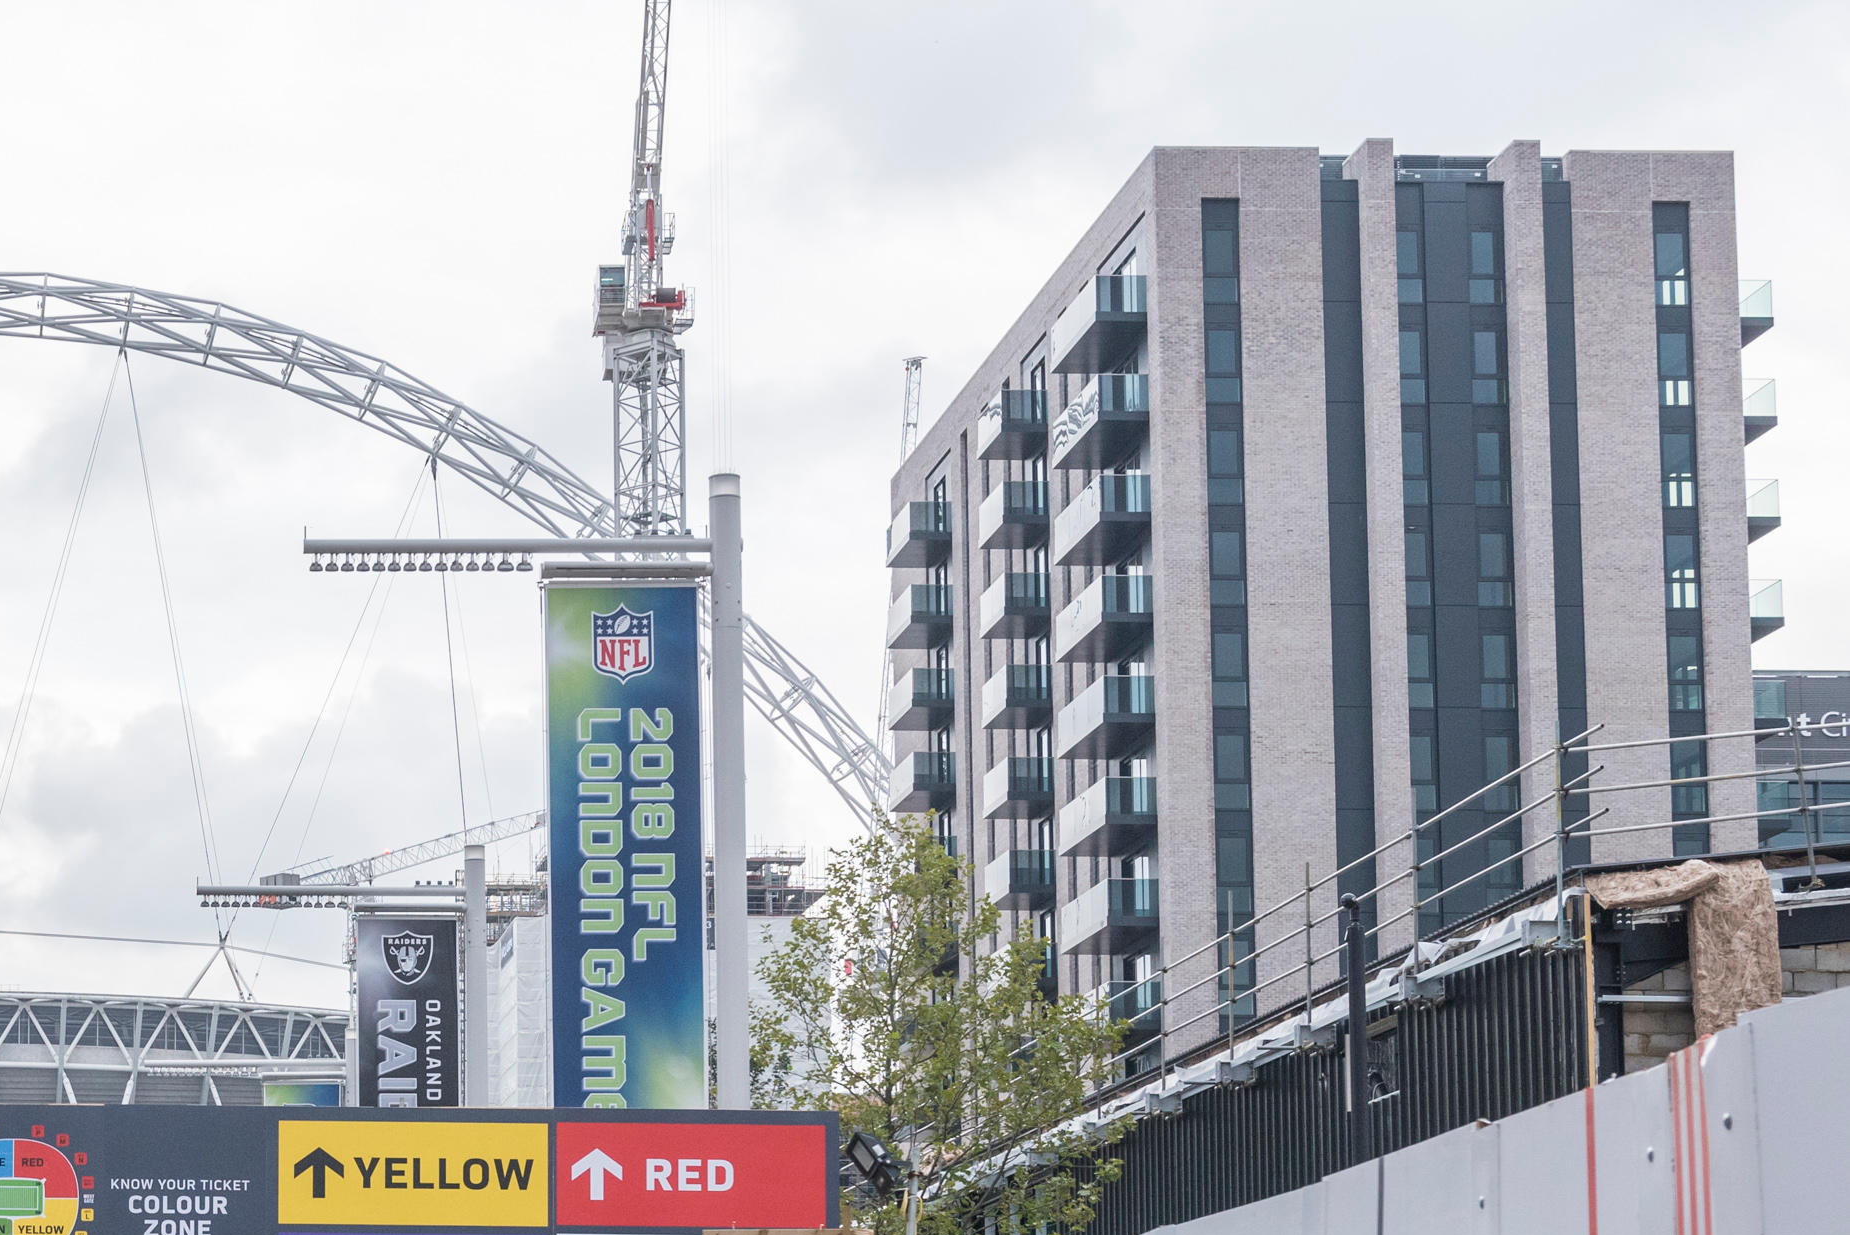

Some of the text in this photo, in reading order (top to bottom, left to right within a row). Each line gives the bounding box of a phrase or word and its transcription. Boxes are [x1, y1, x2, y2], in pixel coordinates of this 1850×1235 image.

[600, 638, 646, 671] NFL
[577, 707, 625, 935] LONDON
[630, 707, 677, 962] 2018 NFL
[388, 938, 428, 946] RAIDERS
[425, 999, 442, 1101] OAKLAND
[22, 1158, 44, 1167] RED
[353, 1157, 534, 1190] YELLOW
[646, 1158, 734, 1192] RED
[110, 1178, 250, 1192] KNOW YOUR TICKET
[128, 1195, 228, 1215] COLOUR
[18, 1225, 64, 1234] YELLOW
